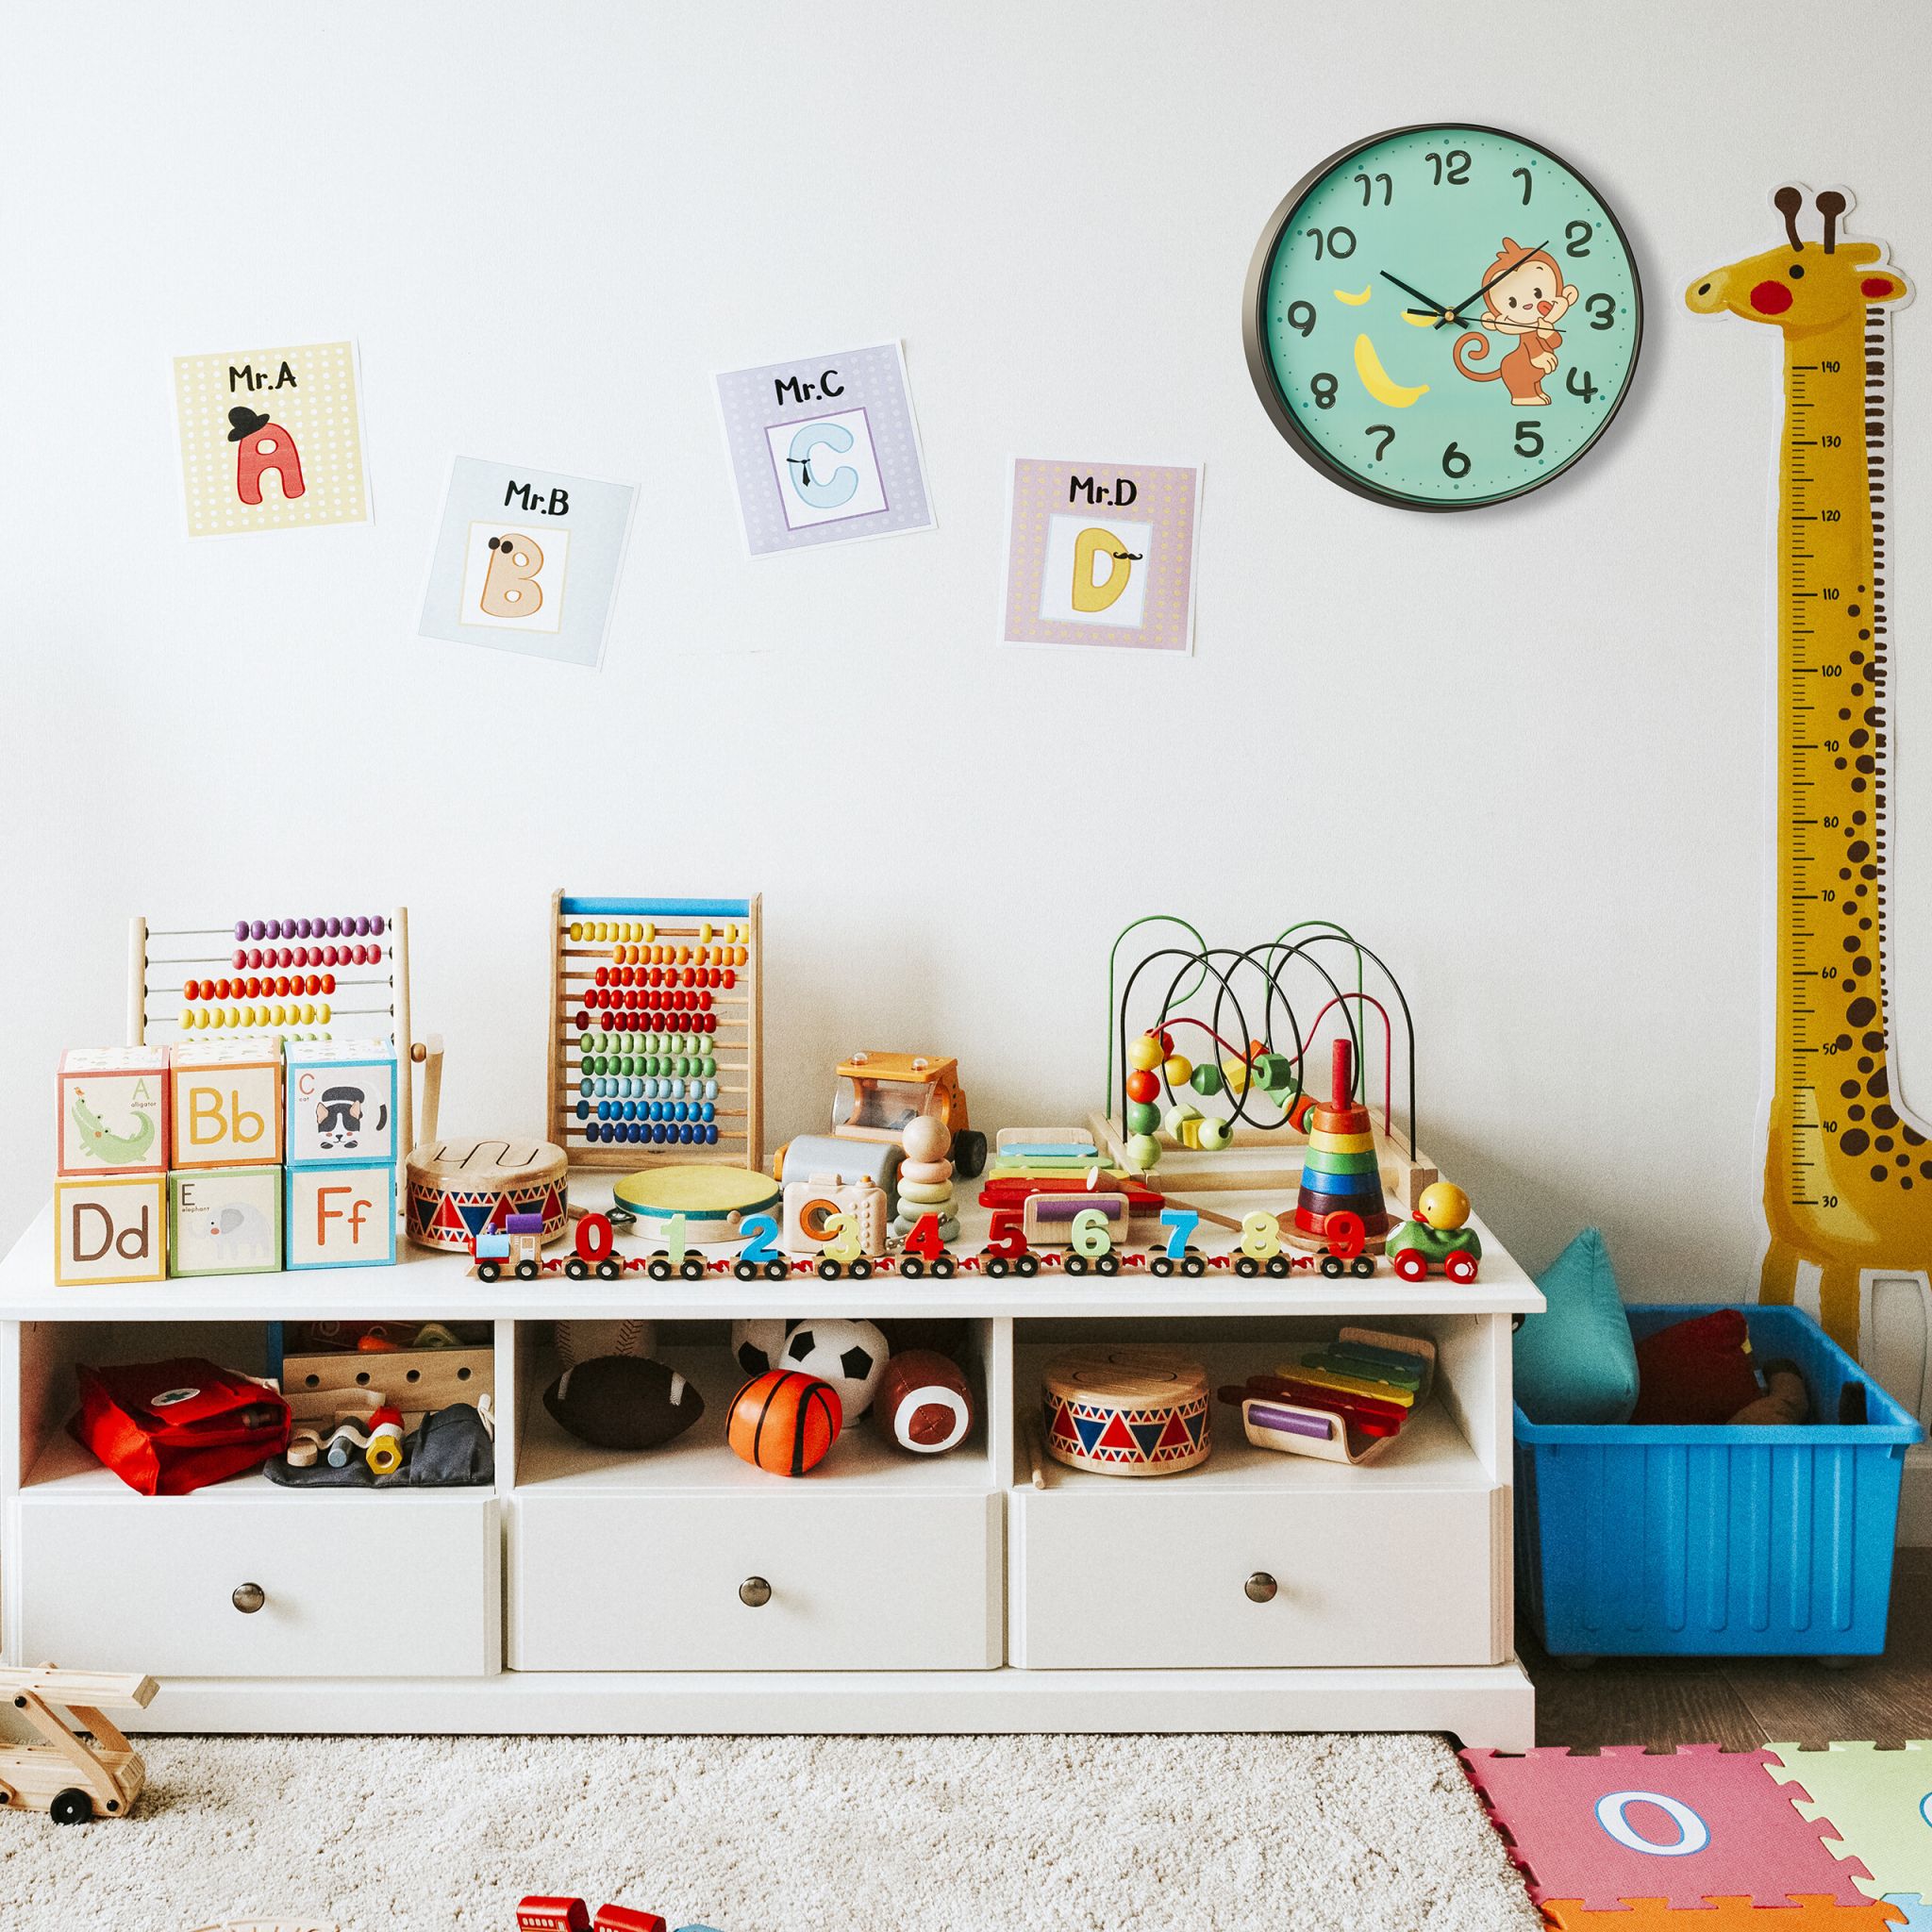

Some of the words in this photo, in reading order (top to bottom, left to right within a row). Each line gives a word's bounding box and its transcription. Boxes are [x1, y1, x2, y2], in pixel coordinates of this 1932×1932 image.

[1425, 150, 1472, 185] 12
[1354, 174, 1393, 207] 11
[1512, 167, 1533, 206] 1
[1306, 225, 1357, 260] 10
[1565, 220, 1593, 258] 2
[1287, 300, 1317, 338] 9
[1585, 292, 1616, 330] 3
[228, 360, 298, 393] Mr.A
[1821, 360, 1840, 374] 140
[774, 369, 845, 407] Mr.C
[1310, 373, 1339, 409] 8
[1566, 367, 1599, 405] 4
[1365, 424, 1396, 461] 7
[1513, 421, 1544, 458] 5
[1822, 435, 1841, 448] 130
[236, 422, 307, 506] A
[788, 422, 859, 509] C
[1441, 441, 1472, 479] 6
[504, 479, 570, 516] Mr.B
[1069, 475, 1138, 508] Mr.D
[1821, 509, 1841, 523] 120
[479, 532, 544, 619] B
[1071, 527, 1132, 613] D
[1823, 588, 1840, 601] 110
[1822, 664, 1842, 677] 100
[1824, 740, 1840, 752] 90
[1824, 816, 1840, 828] 80
[1821, 890, 1836, 902] 70
[1822, 966, 1838, 979] 60
[1823, 1042, 1838, 1056] 50
[132, 1077, 150, 1101] A
[299, 1073, 315, 1095] C
[189, 1087, 265, 1145] Bb
[1823, 1120, 1838, 1133] 40
[181, 1183, 195, 1207] E
[1822, 1195, 1839, 1208] 30
[73, 1202, 149, 1262] Dd
[317, 1186, 373, 1246] Ff
[660, 1213, 686, 1261] 1
[740, 1213, 778, 1261] 2
[823, 1213, 861, 1260] 3
[905, 1212, 944, 1260] 4
[988, 1210, 1027, 1257] 5
[1072, 1208, 1110, 1257] 6
[1159, 1209, 1199, 1258] 7
[1241, 1210, 1280, 1258] 8
[1324, 1210, 1365, 1258] 9
